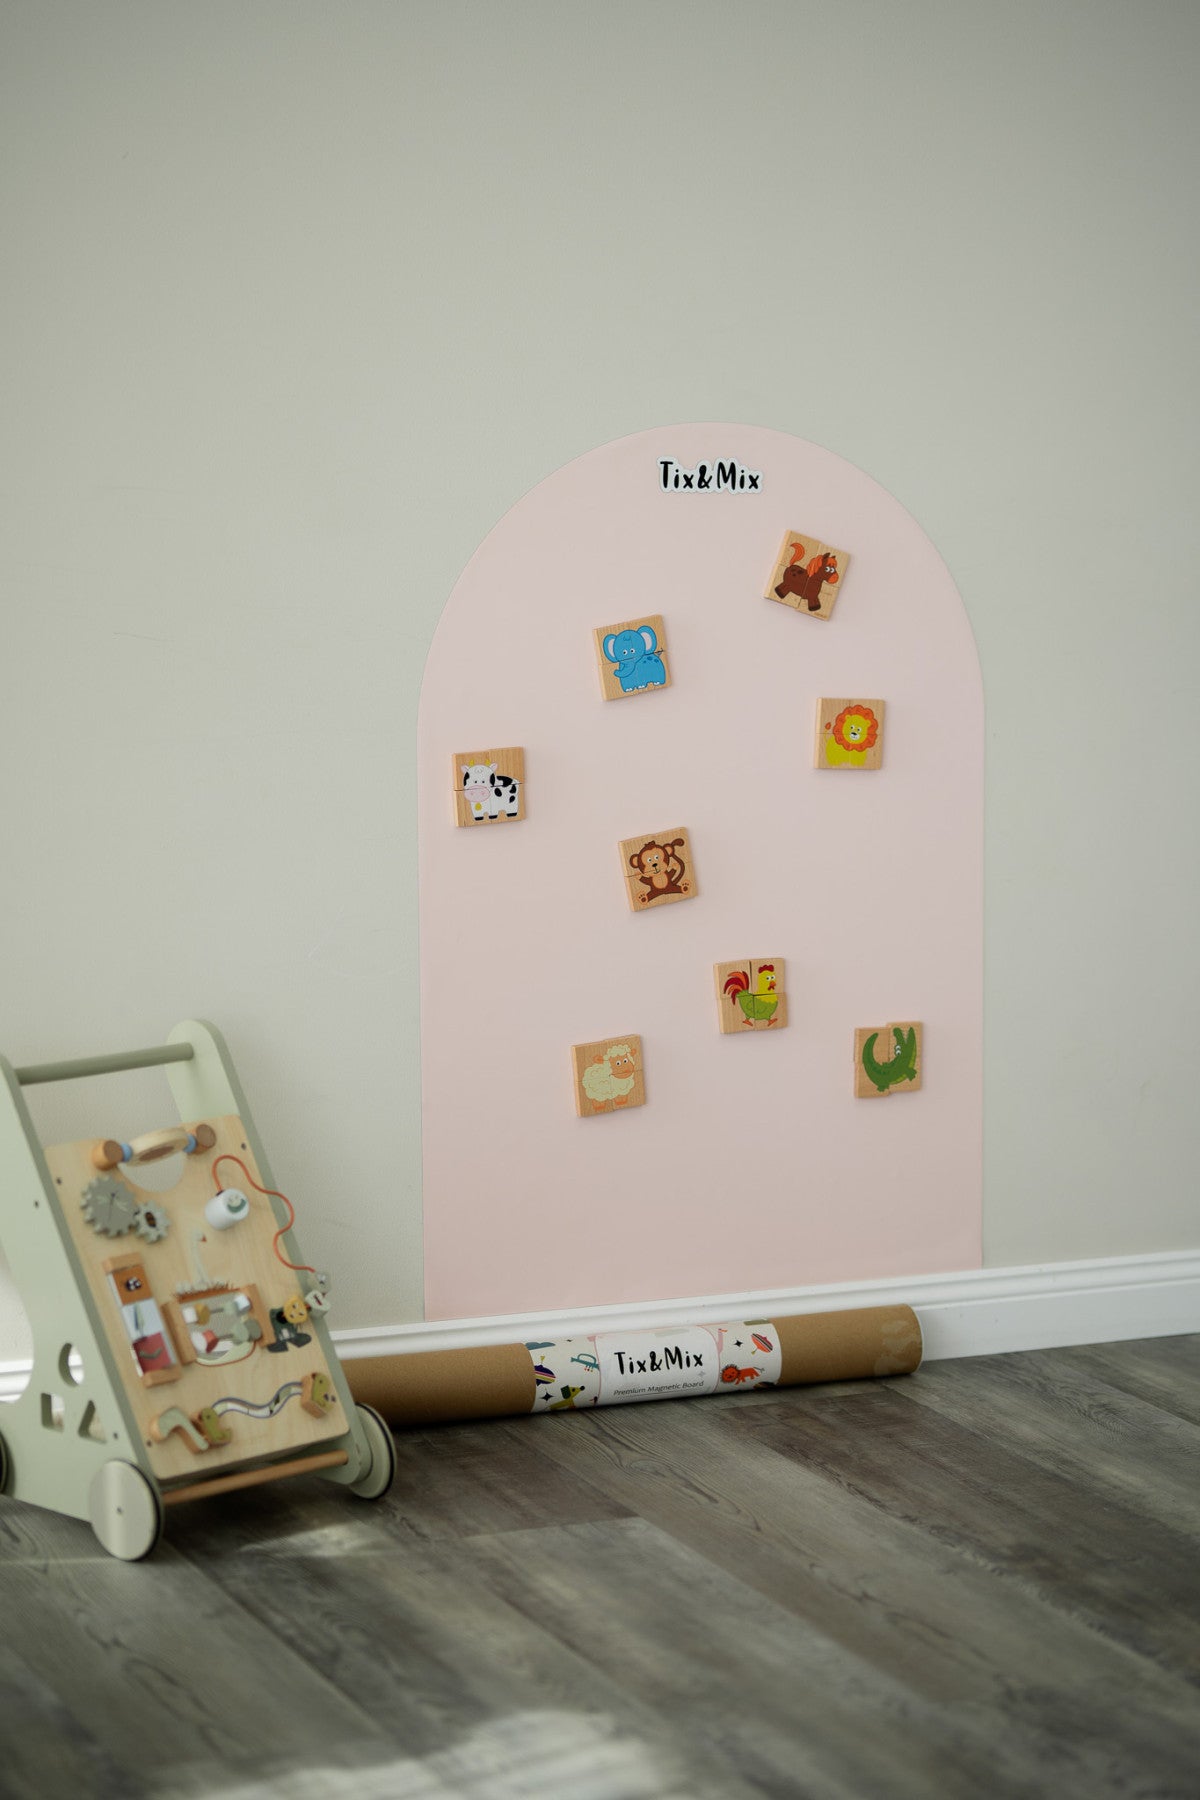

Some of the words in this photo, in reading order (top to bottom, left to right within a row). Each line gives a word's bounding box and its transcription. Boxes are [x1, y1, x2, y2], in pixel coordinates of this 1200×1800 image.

[660, 461, 759, 490] Tix&Mix
[614, 1346, 703, 1375] Tix&Mix
[613, 1387, 646, 1396] Premium
[647, 1383, 681, 1392] Magnetic
[682, 1380, 705, 1389] Board
